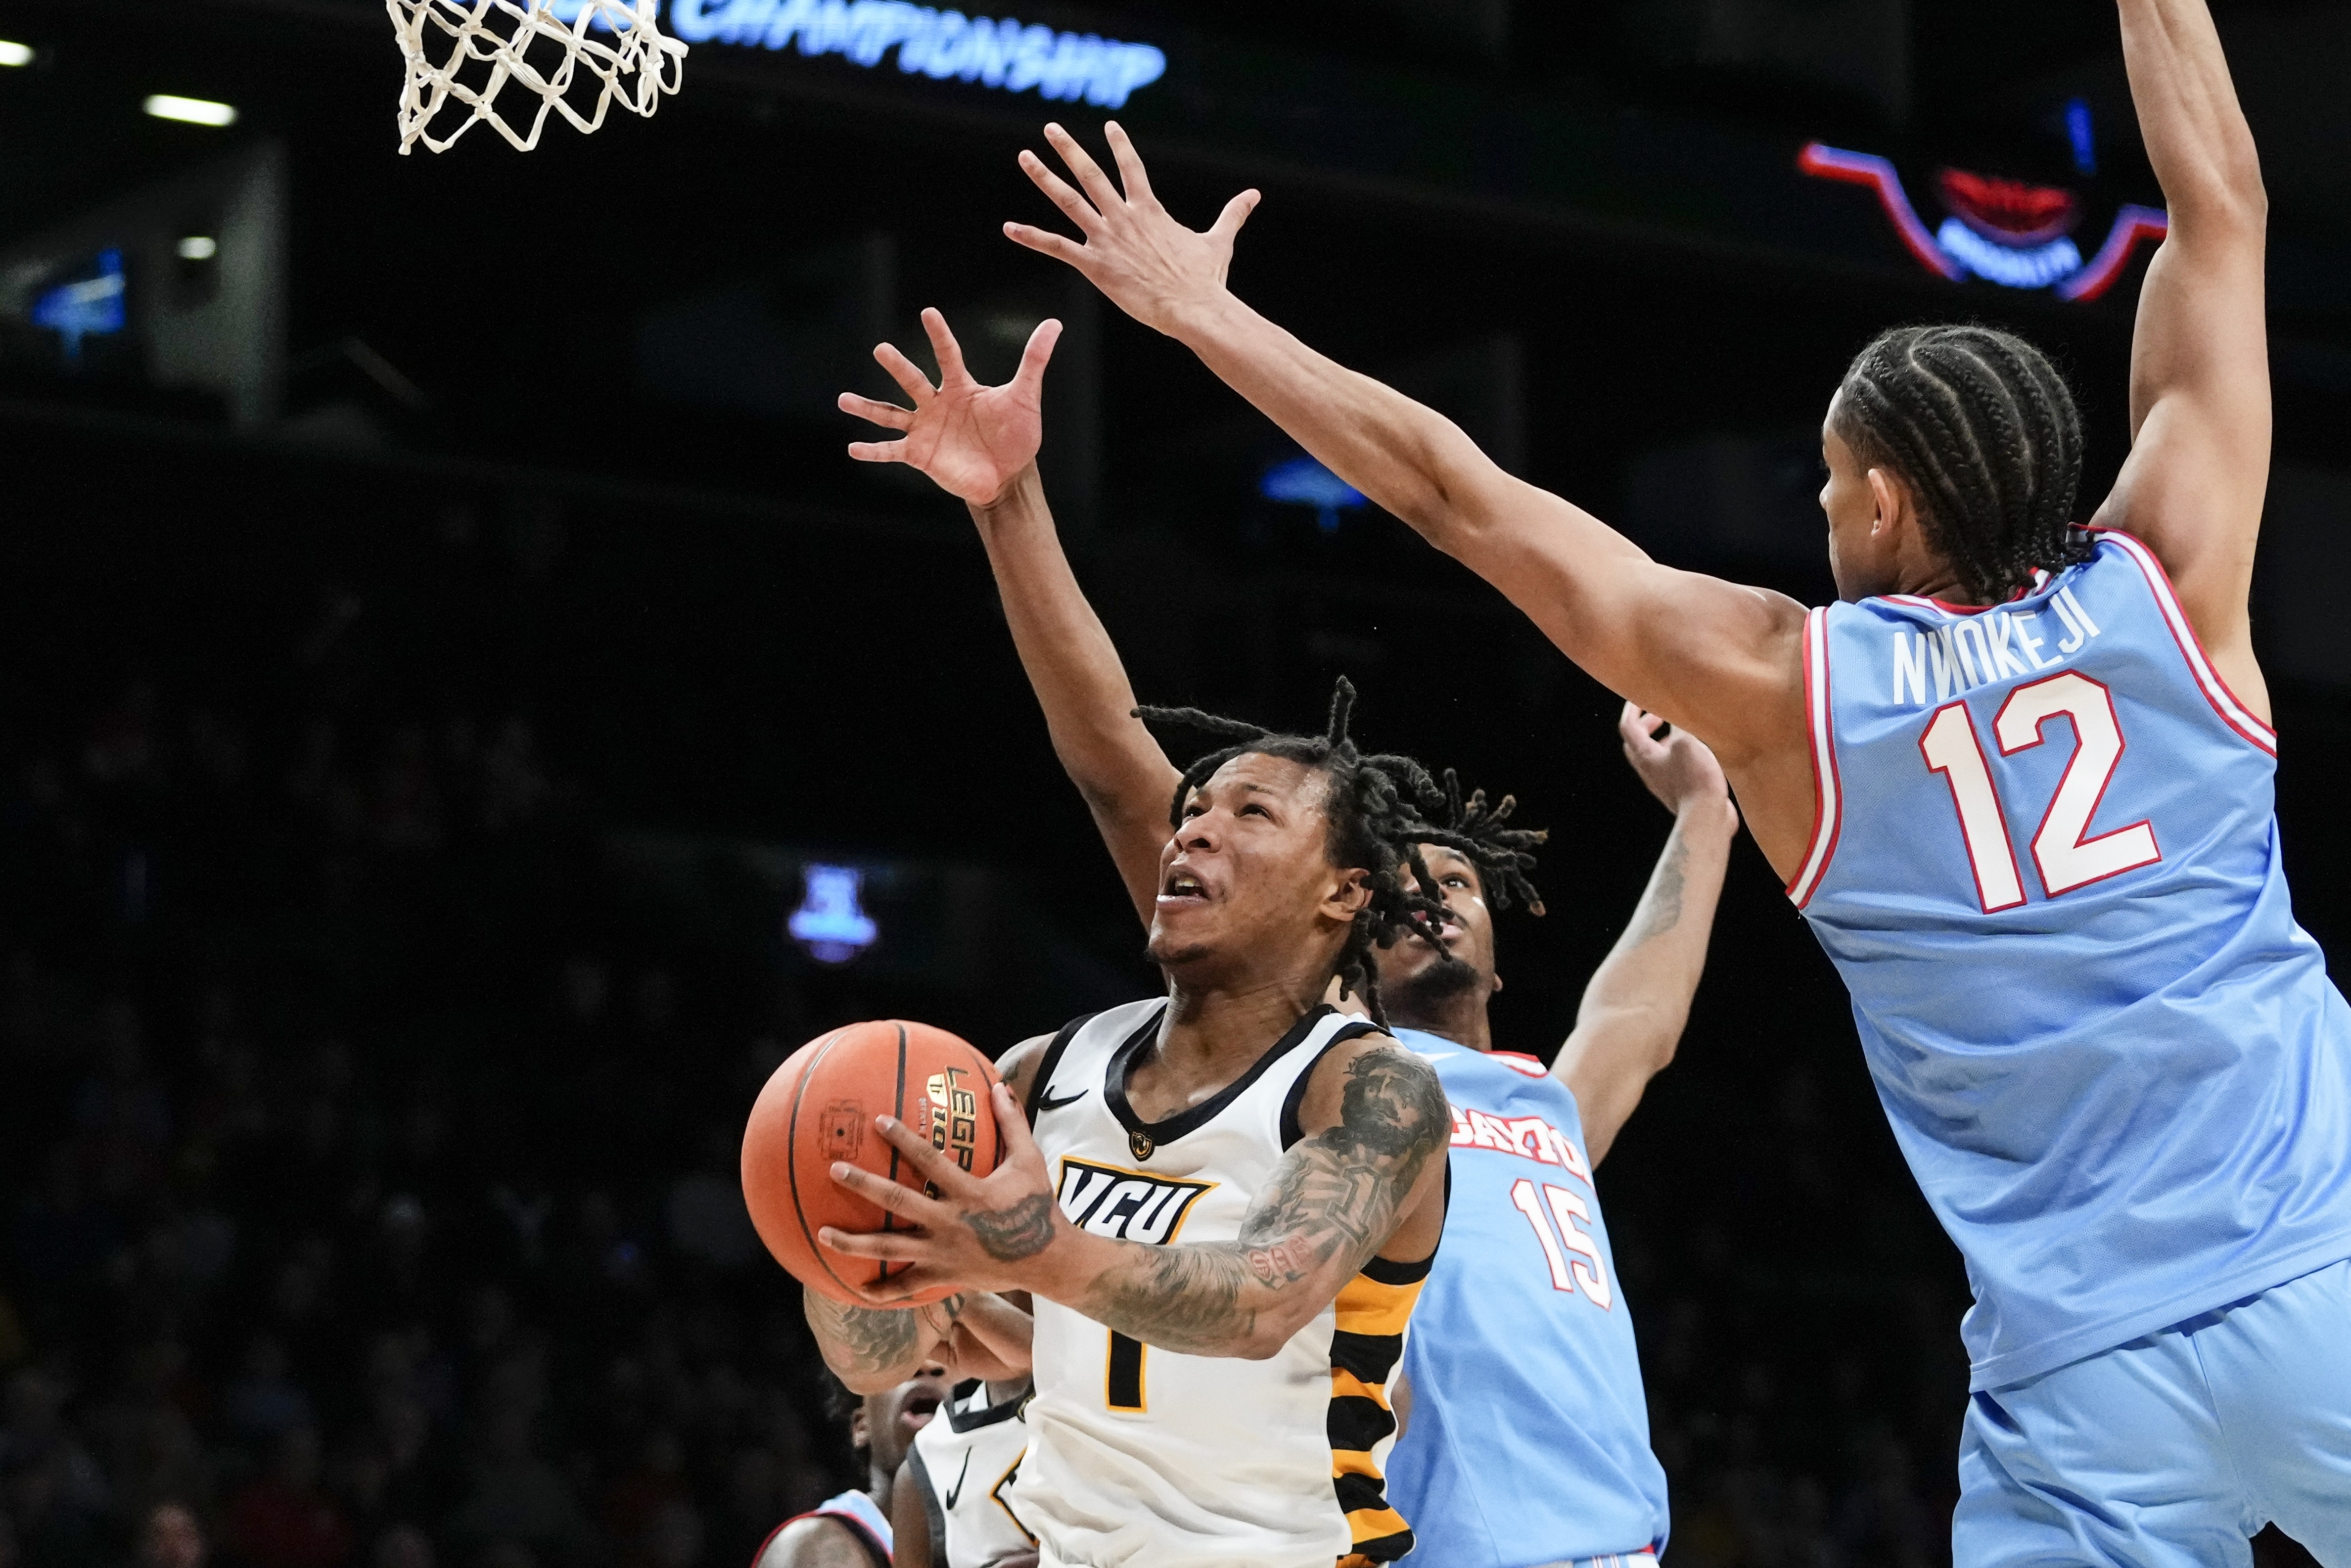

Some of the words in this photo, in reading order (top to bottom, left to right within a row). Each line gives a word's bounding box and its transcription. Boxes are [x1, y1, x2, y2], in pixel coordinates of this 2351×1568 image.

[1893, 585, 2100, 705] NWOKEJI
[1918, 669, 2162, 915] 12
[1059, 1166, 1198, 1244] VCU
[1510, 1178, 1612, 1312] 15
